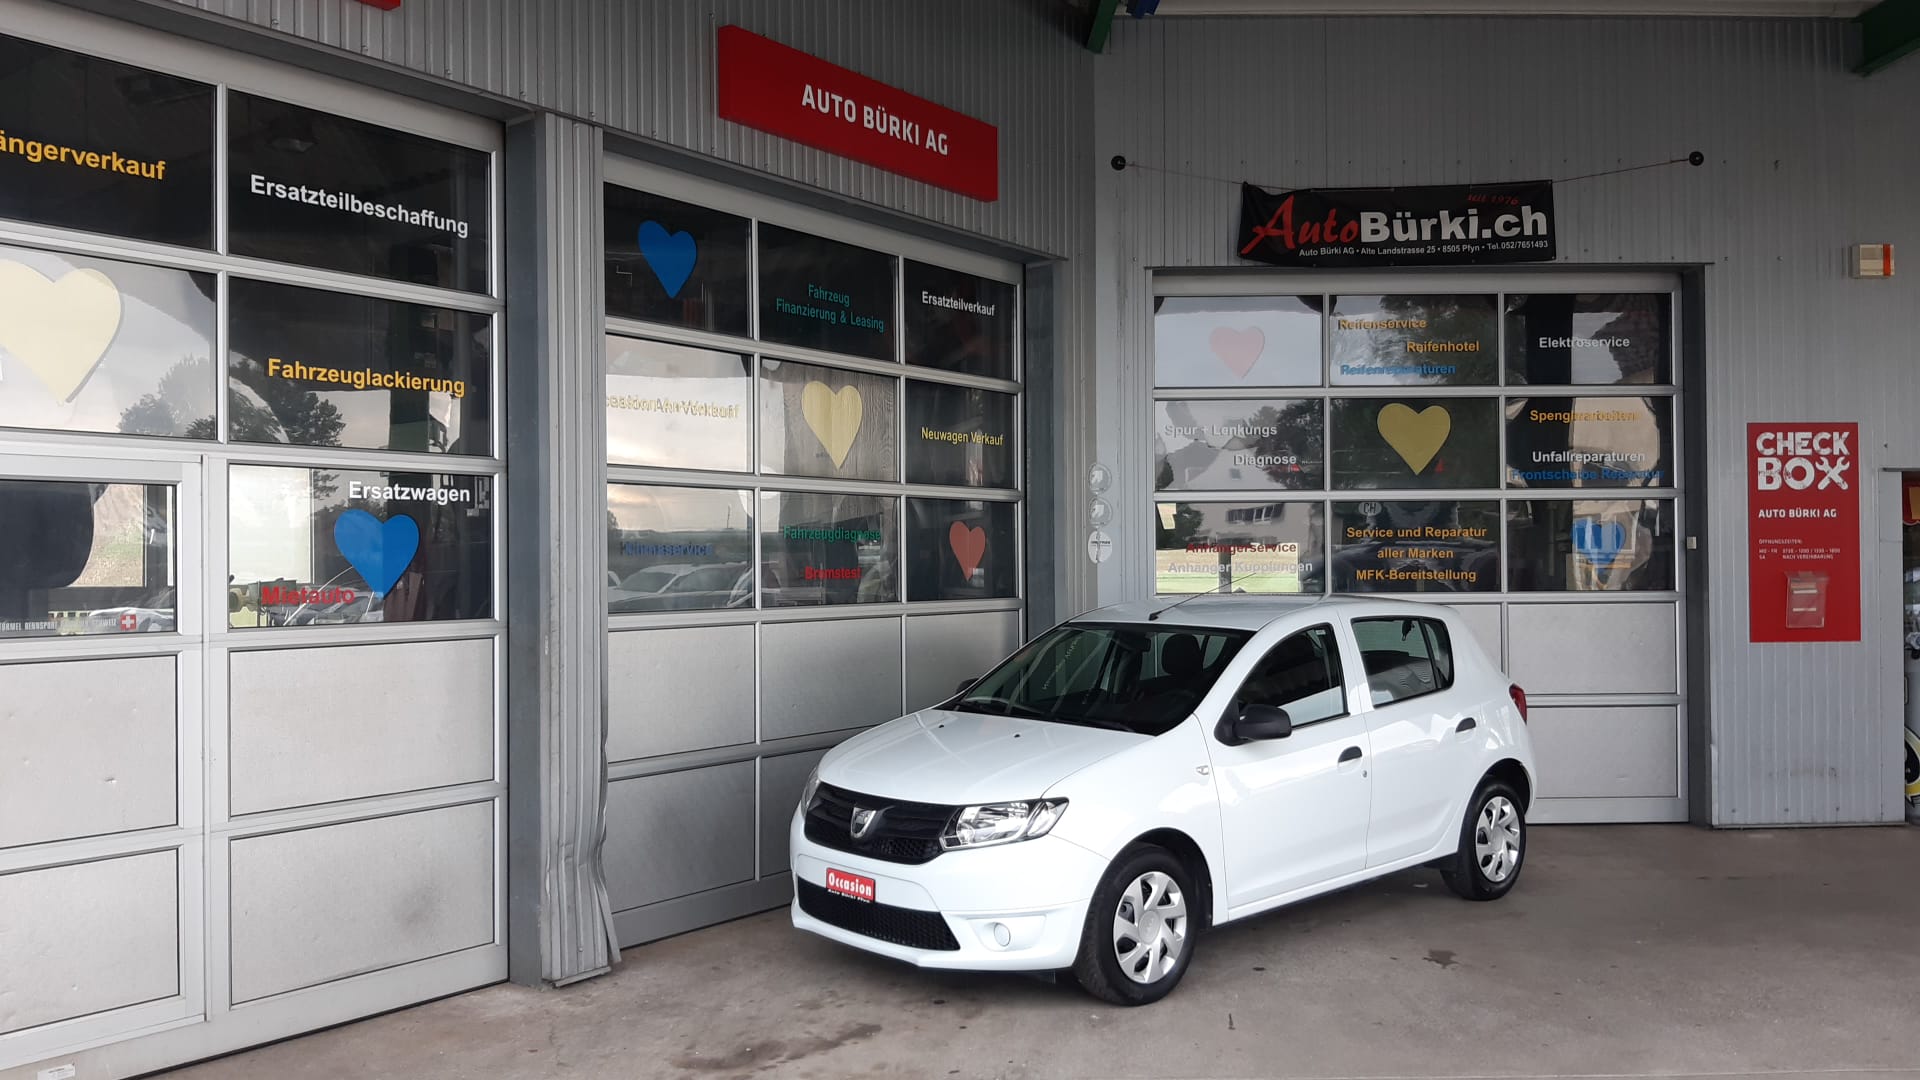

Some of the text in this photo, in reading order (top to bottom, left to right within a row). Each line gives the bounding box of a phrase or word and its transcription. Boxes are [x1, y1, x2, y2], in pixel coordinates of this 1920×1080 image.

[801, 84, 948, 156] AUTO BÜRKI AG
[250, 173, 469, 239] Ersatzteilbeschaffung
[1299, 247, 1319, 257] Auto
[1320, 246, 1342, 256] Bürki
[1342, 246, 1355, 255] AG
[1360, 246, 1376, 255] Alte
[1377, 245, 1425, 255] Landstrasse
[1426, 245, 1436, 254] 25
[1442, 244, 1461, 253] 8505
[1462, 244, 1480, 254] Pfyn
[808, 283, 850, 307] Fahrzeug
[922, 290, 996, 317] Ersatzteilverkauf
[776, 297, 885, 333] Finanzierung & Leasing
[1338, 319, 1428, 330] Reifenservice
[1406, 340, 1480, 353] Reifenhotel
[1538, 336, 1631, 349] Elektroservice
[1339, 364, 1457, 376] Reifenreparaturen
[267, 357, 466, 399] Fahrzeuglackierung
[921, 426, 1004, 446] Neuwagen Verkauf
[1164, 424, 1198, 438] Spur
[1212, 424, 1278, 438] Lenkungs
[1756, 431, 1850, 456] CHECK
[1233, 453, 1297, 467] Diagnose
[1532, 451, 1646, 464] Unfallreparaturen
[1757, 456, 1850, 490] BOX
[348, 480, 471, 505] Ersatzwagen
[1758, 506, 1837, 518] AUTO BÜRKI AG
[783, 524, 882, 544] Fahrzeugdiagnose
[1346, 526, 1488, 540] Service und Reparatur
[1377, 548, 1454, 559] aller Marken
[804, 566, 862, 581] Bremstest
[1234, 561, 1313, 574] Kupplungen
[1356, 568, 1477, 583] MFK-Bereitstellung
[261, 585, 355, 605] Mietauto
[828, 872, 872, 897] Occasion
